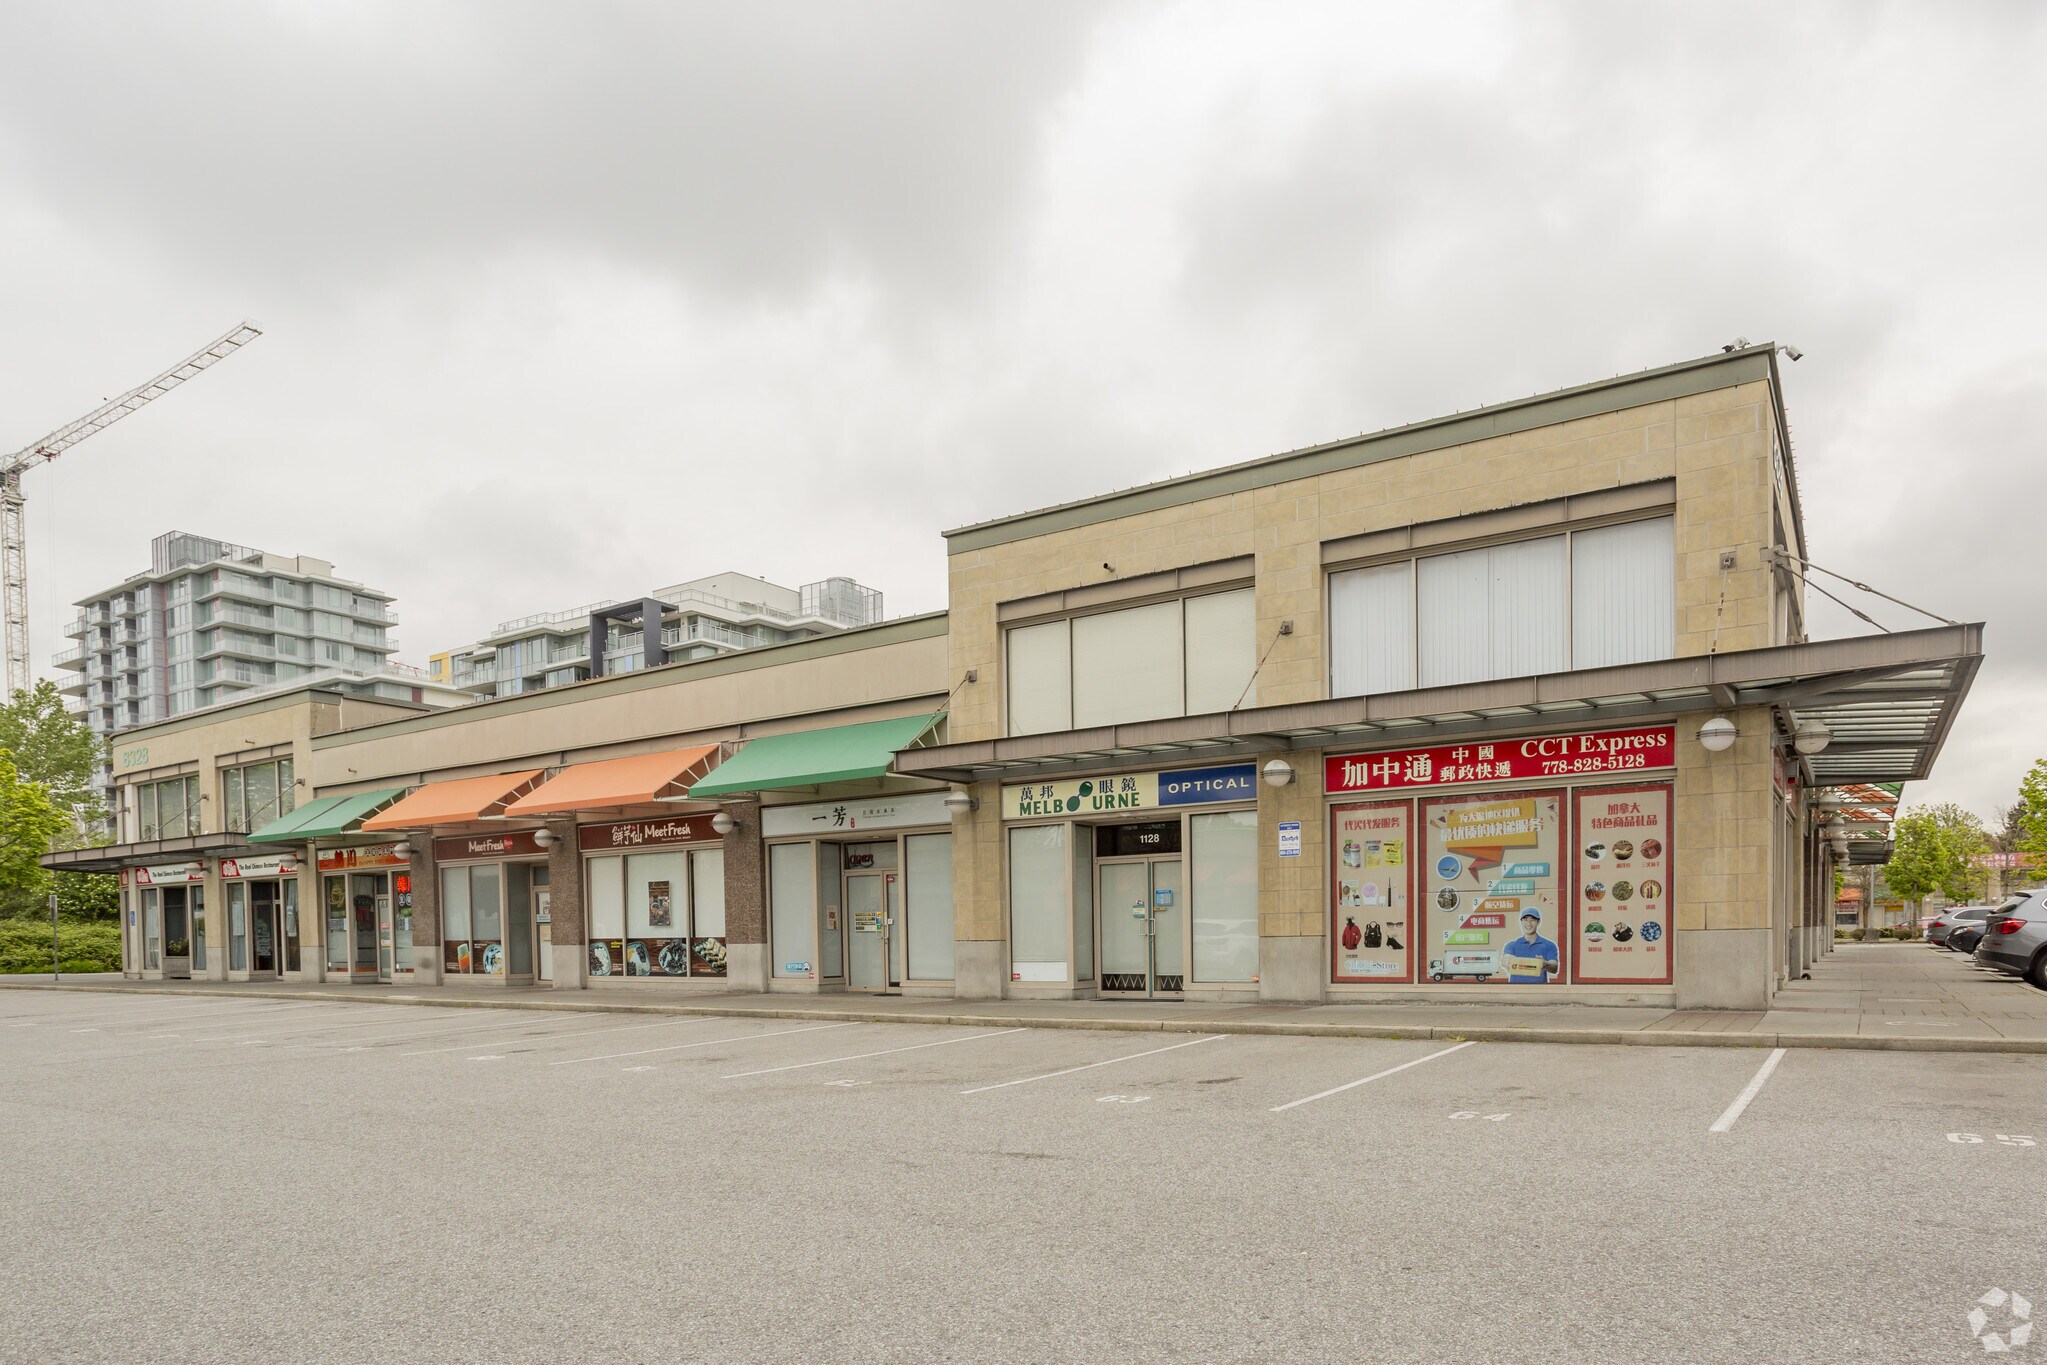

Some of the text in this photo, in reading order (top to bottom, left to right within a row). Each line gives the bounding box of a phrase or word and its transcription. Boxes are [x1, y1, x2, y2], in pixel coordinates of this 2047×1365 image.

[1452, 744, 1495, 764] 中國
[1520, 732, 1668, 758] CCT Express
[123, 747, 149, 768] 8328
[1541, 753, 1646, 775] 778-828-5128
[1341, 753, 1433, 788] 加中通
[1439, 760, 1512, 782] 郵政快遞
[1020, 777, 1137, 802] 萬邦 眼鏡
[1167, 777, 1250, 794] OPTICAL
[812, 805, 847, 827] 一芳
[1607, 802, 1641, 815] 加拿大
[1591, 814, 1658, 829] 特色商品礼品
[1139, 833, 1160, 844] 1128
[1946, 1132, 2037, 1147] 65
